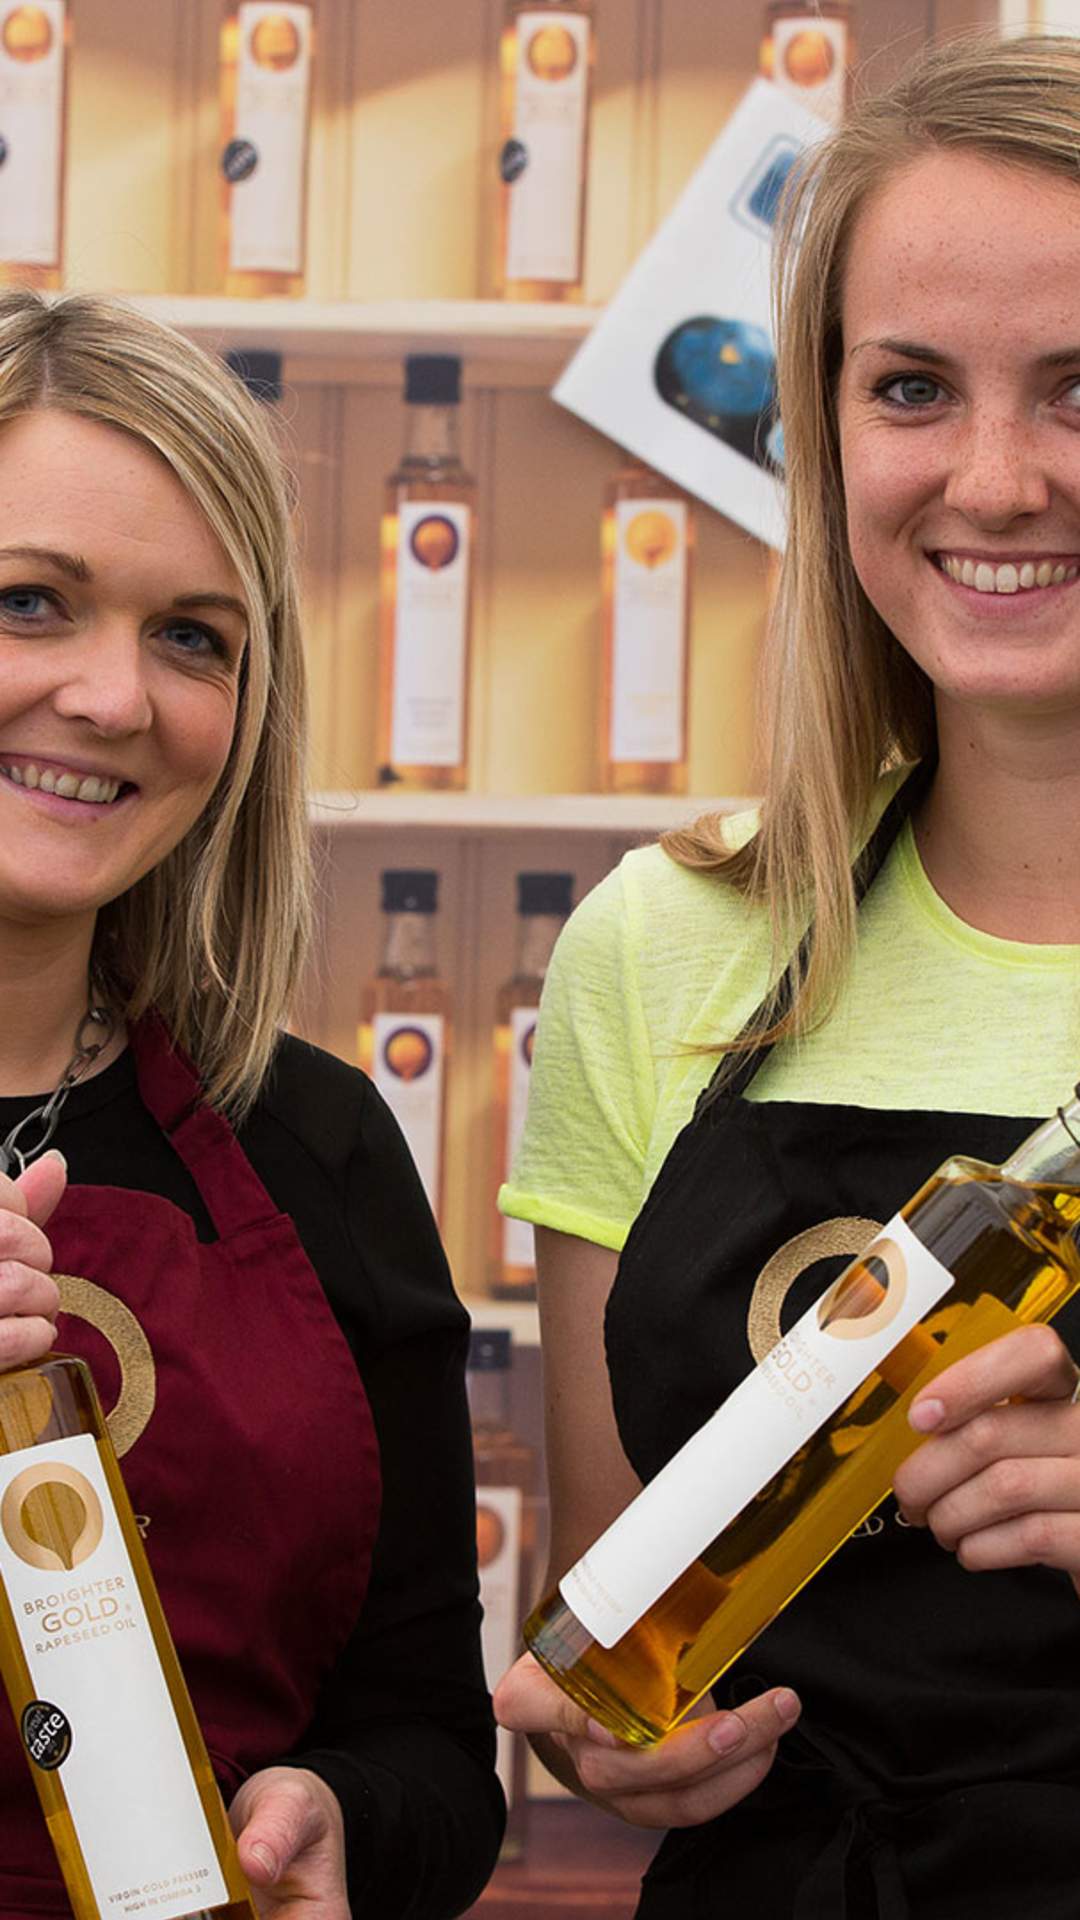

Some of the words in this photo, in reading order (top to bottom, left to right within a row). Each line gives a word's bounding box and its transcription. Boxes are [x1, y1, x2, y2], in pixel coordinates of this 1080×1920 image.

[22, 1576, 126, 1616] BROIGHTER
[41, 1596, 119, 1634] GOLD
[34, 1624, 111, 1655] RAPESEED
[113, 1617, 137, 1632] OIL
[30, 1712, 66, 1761] taste
